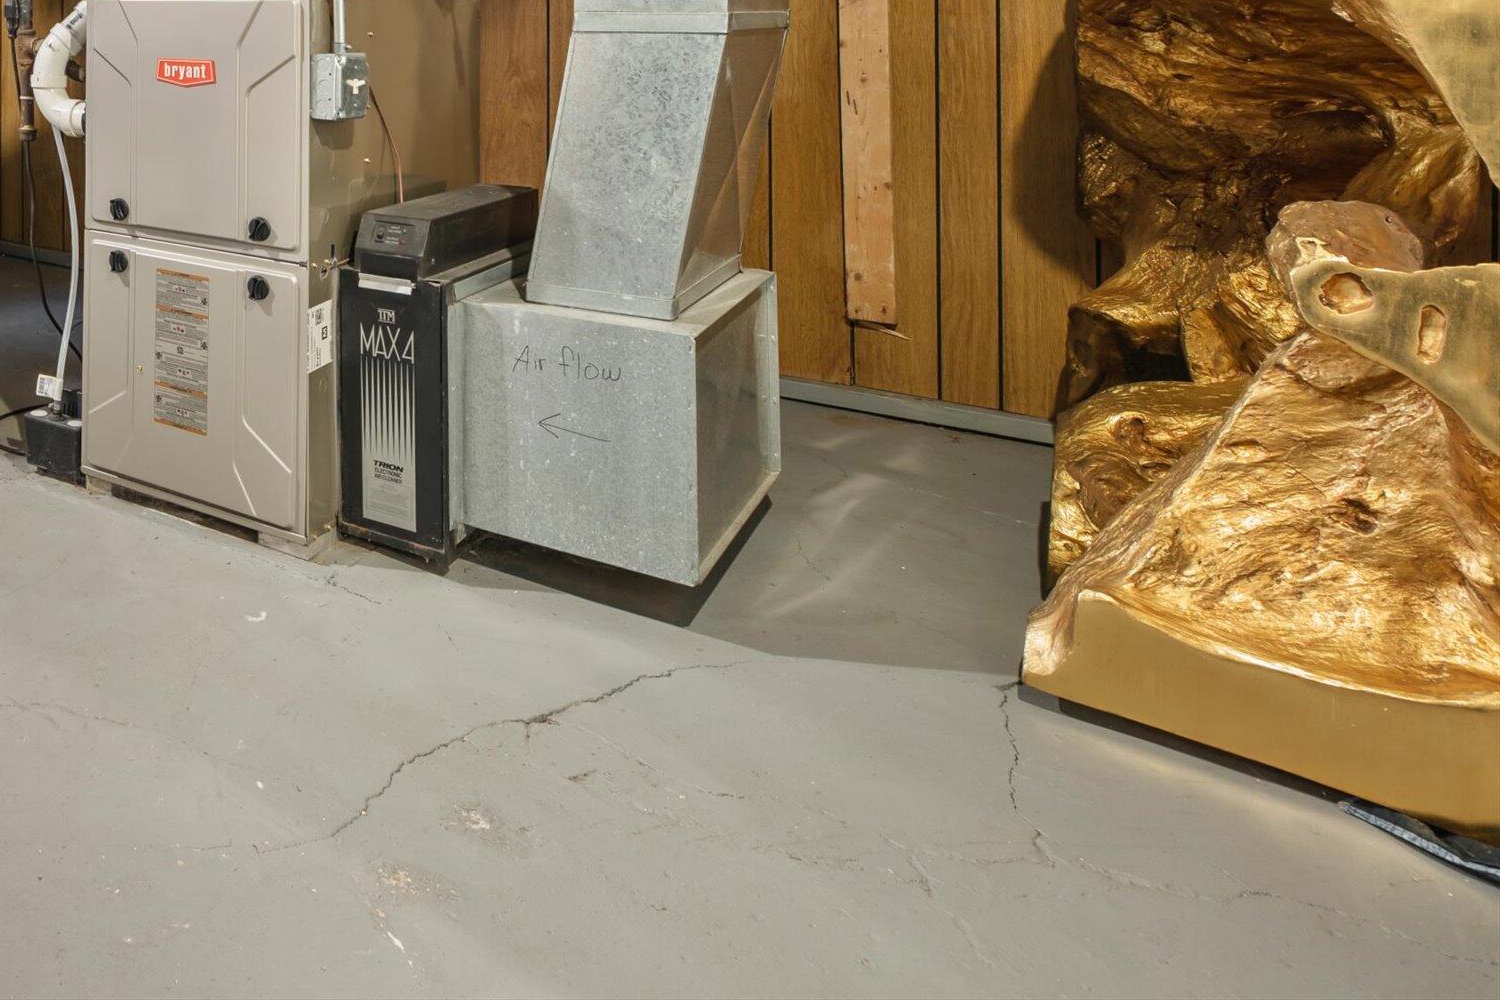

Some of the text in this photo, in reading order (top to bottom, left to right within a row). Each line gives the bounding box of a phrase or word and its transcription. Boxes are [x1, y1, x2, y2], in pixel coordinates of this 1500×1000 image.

[164, 62, 206, 80] bryant
[360, 322, 400, 362] MAX
[402, 330, 414, 364] 4
[512, 345, 621, 381] Air flow
[373, 459, 404, 473] TRION
